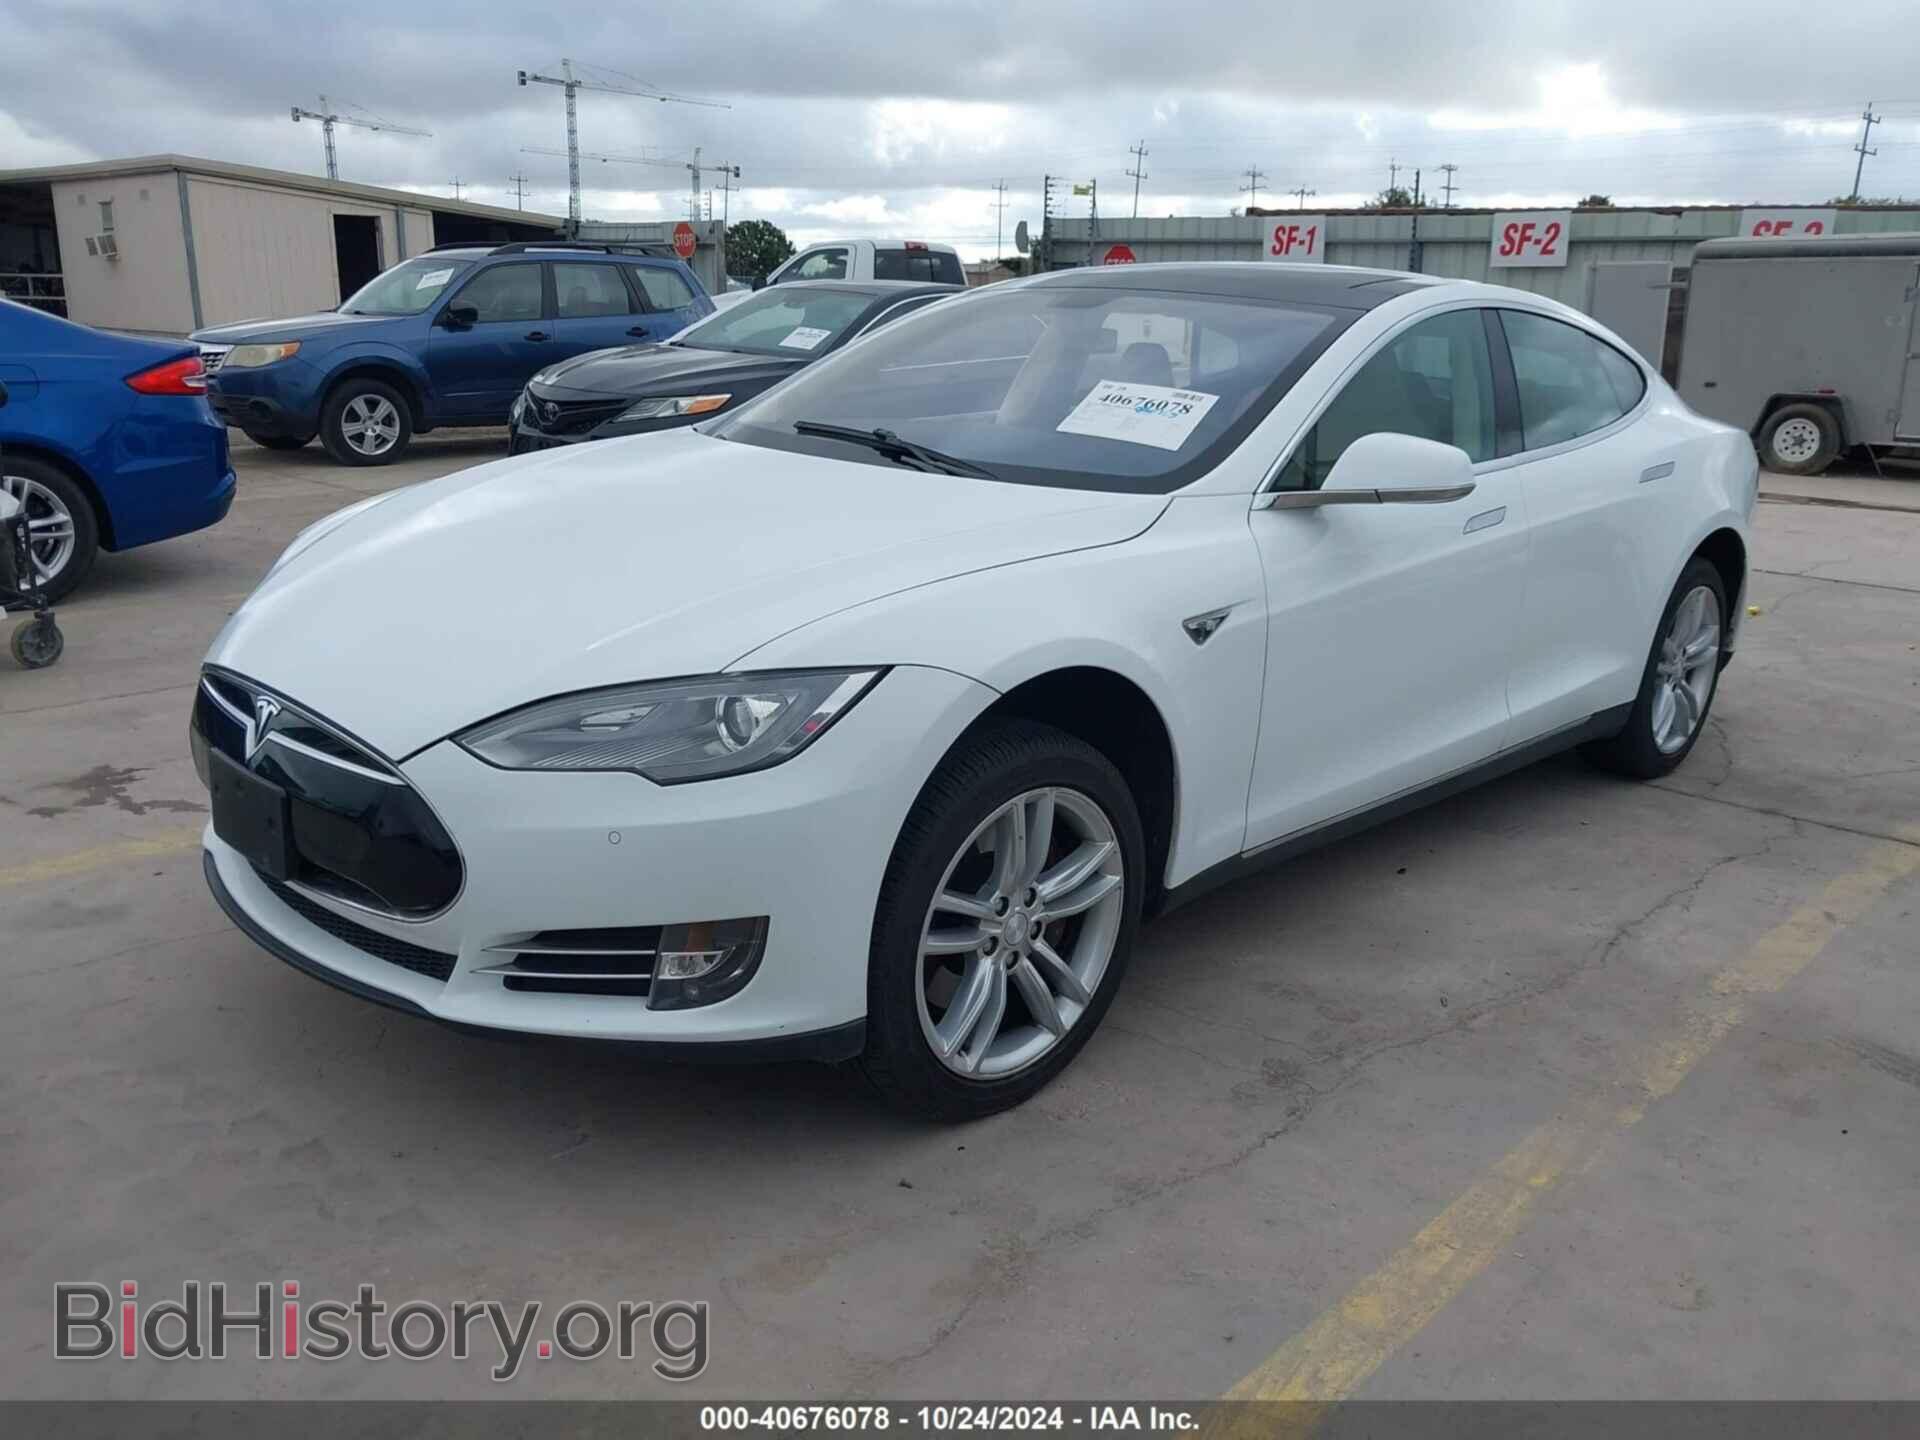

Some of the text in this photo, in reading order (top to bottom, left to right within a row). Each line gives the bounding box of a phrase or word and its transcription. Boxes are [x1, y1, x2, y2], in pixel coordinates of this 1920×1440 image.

[675, 232, 694, 247] STOP
[1271, 224, 1317, 256] SF-1
[1500, 222, 1561, 257] SF-2
